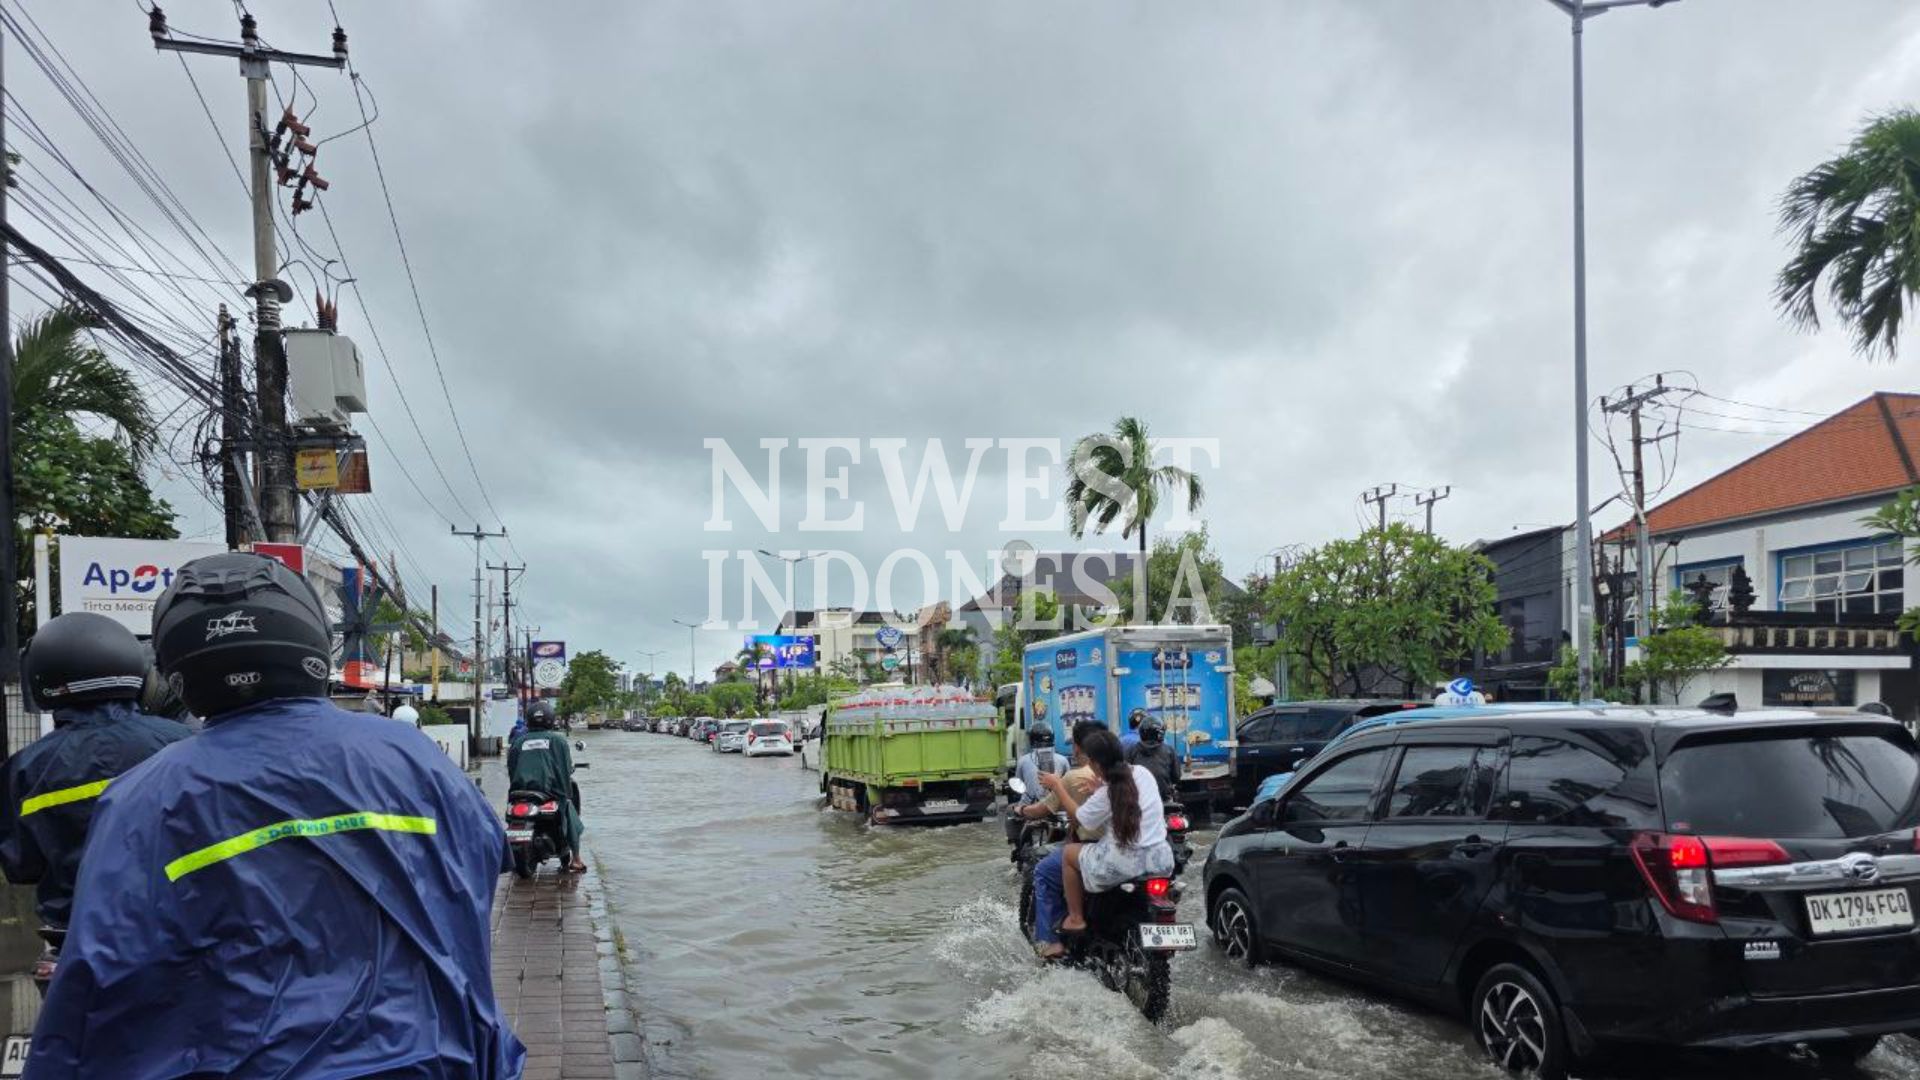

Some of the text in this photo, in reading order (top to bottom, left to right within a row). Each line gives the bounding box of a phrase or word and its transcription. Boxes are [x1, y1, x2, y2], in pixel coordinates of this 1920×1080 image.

[83, 562, 176, 593] Apot
[83, 601, 155, 611] Tirta Medic
[229, 671, 256, 686] DOT
[1810, 893, 1908, 920] DK 1794 FCQ
[1744, 942, 1780, 951] ASTRA
